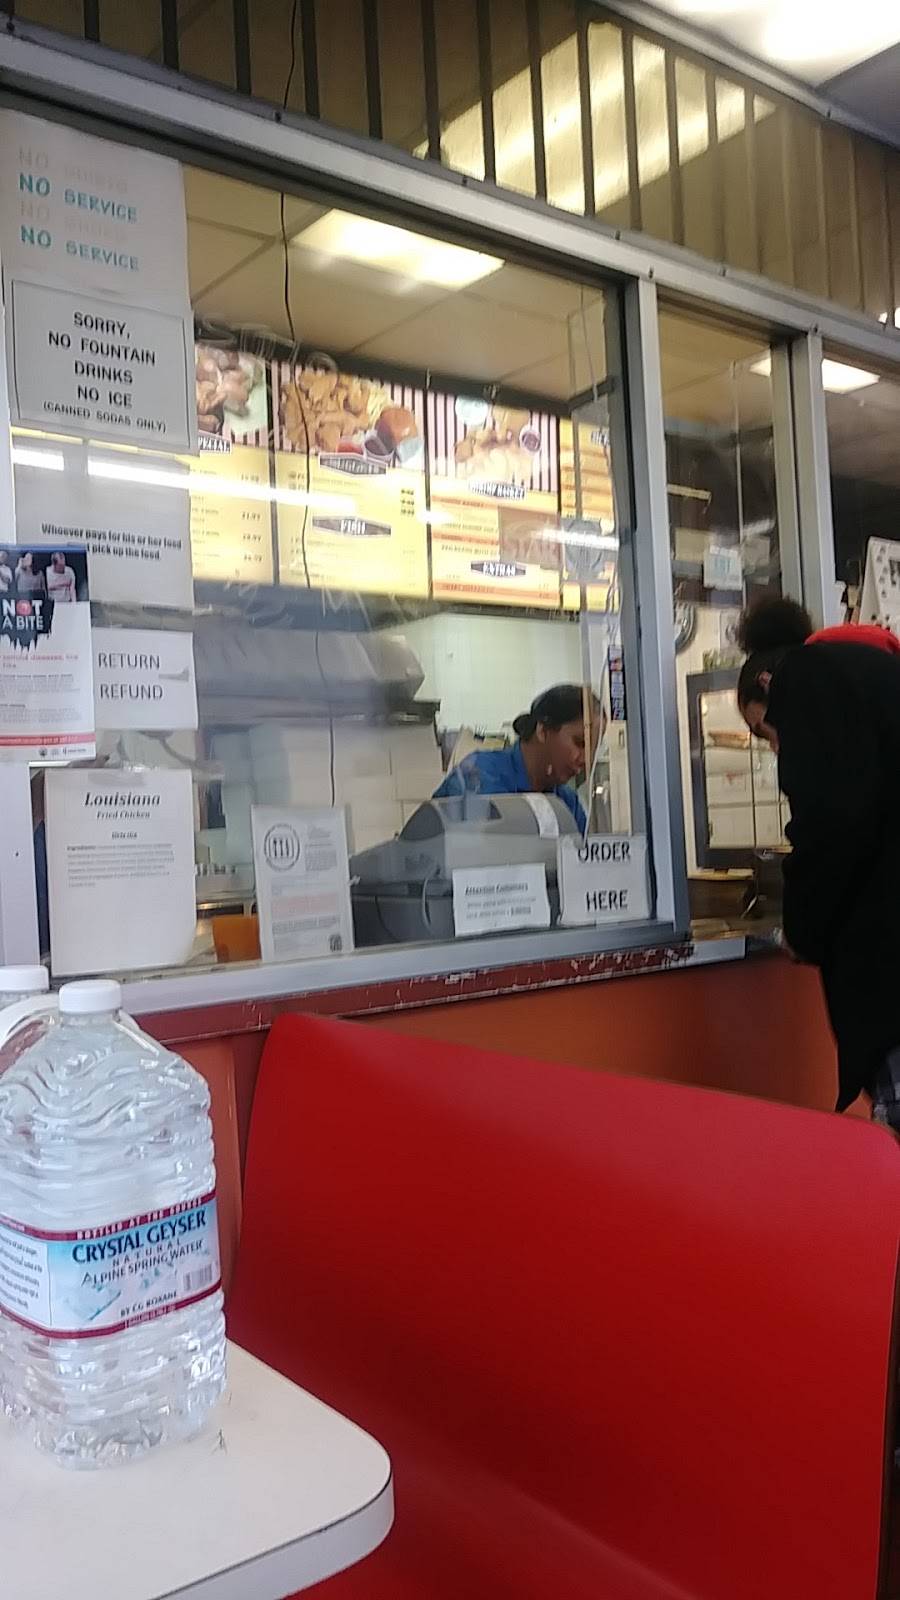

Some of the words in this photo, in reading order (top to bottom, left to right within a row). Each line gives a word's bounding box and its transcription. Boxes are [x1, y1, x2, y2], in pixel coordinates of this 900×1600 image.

[19, 172, 51, 197] NO
[64, 188, 138, 222] SERVICE
[21, 224, 52, 248] NO
[65, 240, 139, 270] SERVICE
[74, 311, 130, 340] SORRY,
[48, 330, 71, 349] NO
[81, 337, 155, 366] FOUNTAIN
[74, 360, 133, 384] DRINKS
[77, 384, 99, 403] NO
[108, 390, 132, 410] ICE
[43, 400, 91, 419] (CANNED
[96, 409, 131, 426] SODAS
[136, 417, 167, 433] ONLY)
[41, 522, 83, 539] Whoever
[85, 530, 107, 541] pays
[108, 530, 121, 541] for
[122, 531, 136, 543] his
[147, 535, 162, 546] her
[163, 537, 182, 550] food
[92, 543, 112, 555] pick
[113, 546, 124, 558] up
[125, 547, 140, 557] the
[141, 548, 161, 561] food
[2, 599, 43, 616] NOT
[2, 615, 14, 630] A
[16, 615, 44, 631] BITE
[97, 652, 160, 670] RETURN
[100, 683, 164, 701] REFUND
[84, 791, 161, 807] Louisiana
[96, 811, 118, 820] Fried
[119, 810, 151, 820] Chicken
[578, 841, 632, 864] ORDER
[586, 889, 629, 912] HERE
[72, 1231, 145, 1264] CRYSTAL
[146, 1208, 207, 1245] GEYSER
[76, 1222, 123, 1241] BOTTLED
[128, 1215, 141, 1228] AT
[147, 1208, 163, 1223] THE
[80, 1267, 127, 1288] ALPINE
[128, 1252, 168, 1275] SPRING
[168, 1238, 204, 1261] WATER
[120, 1307, 130, 1318] BY
[131, 1302, 144, 1313] CG
[145, 1290, 178, 1307] ROXANE
